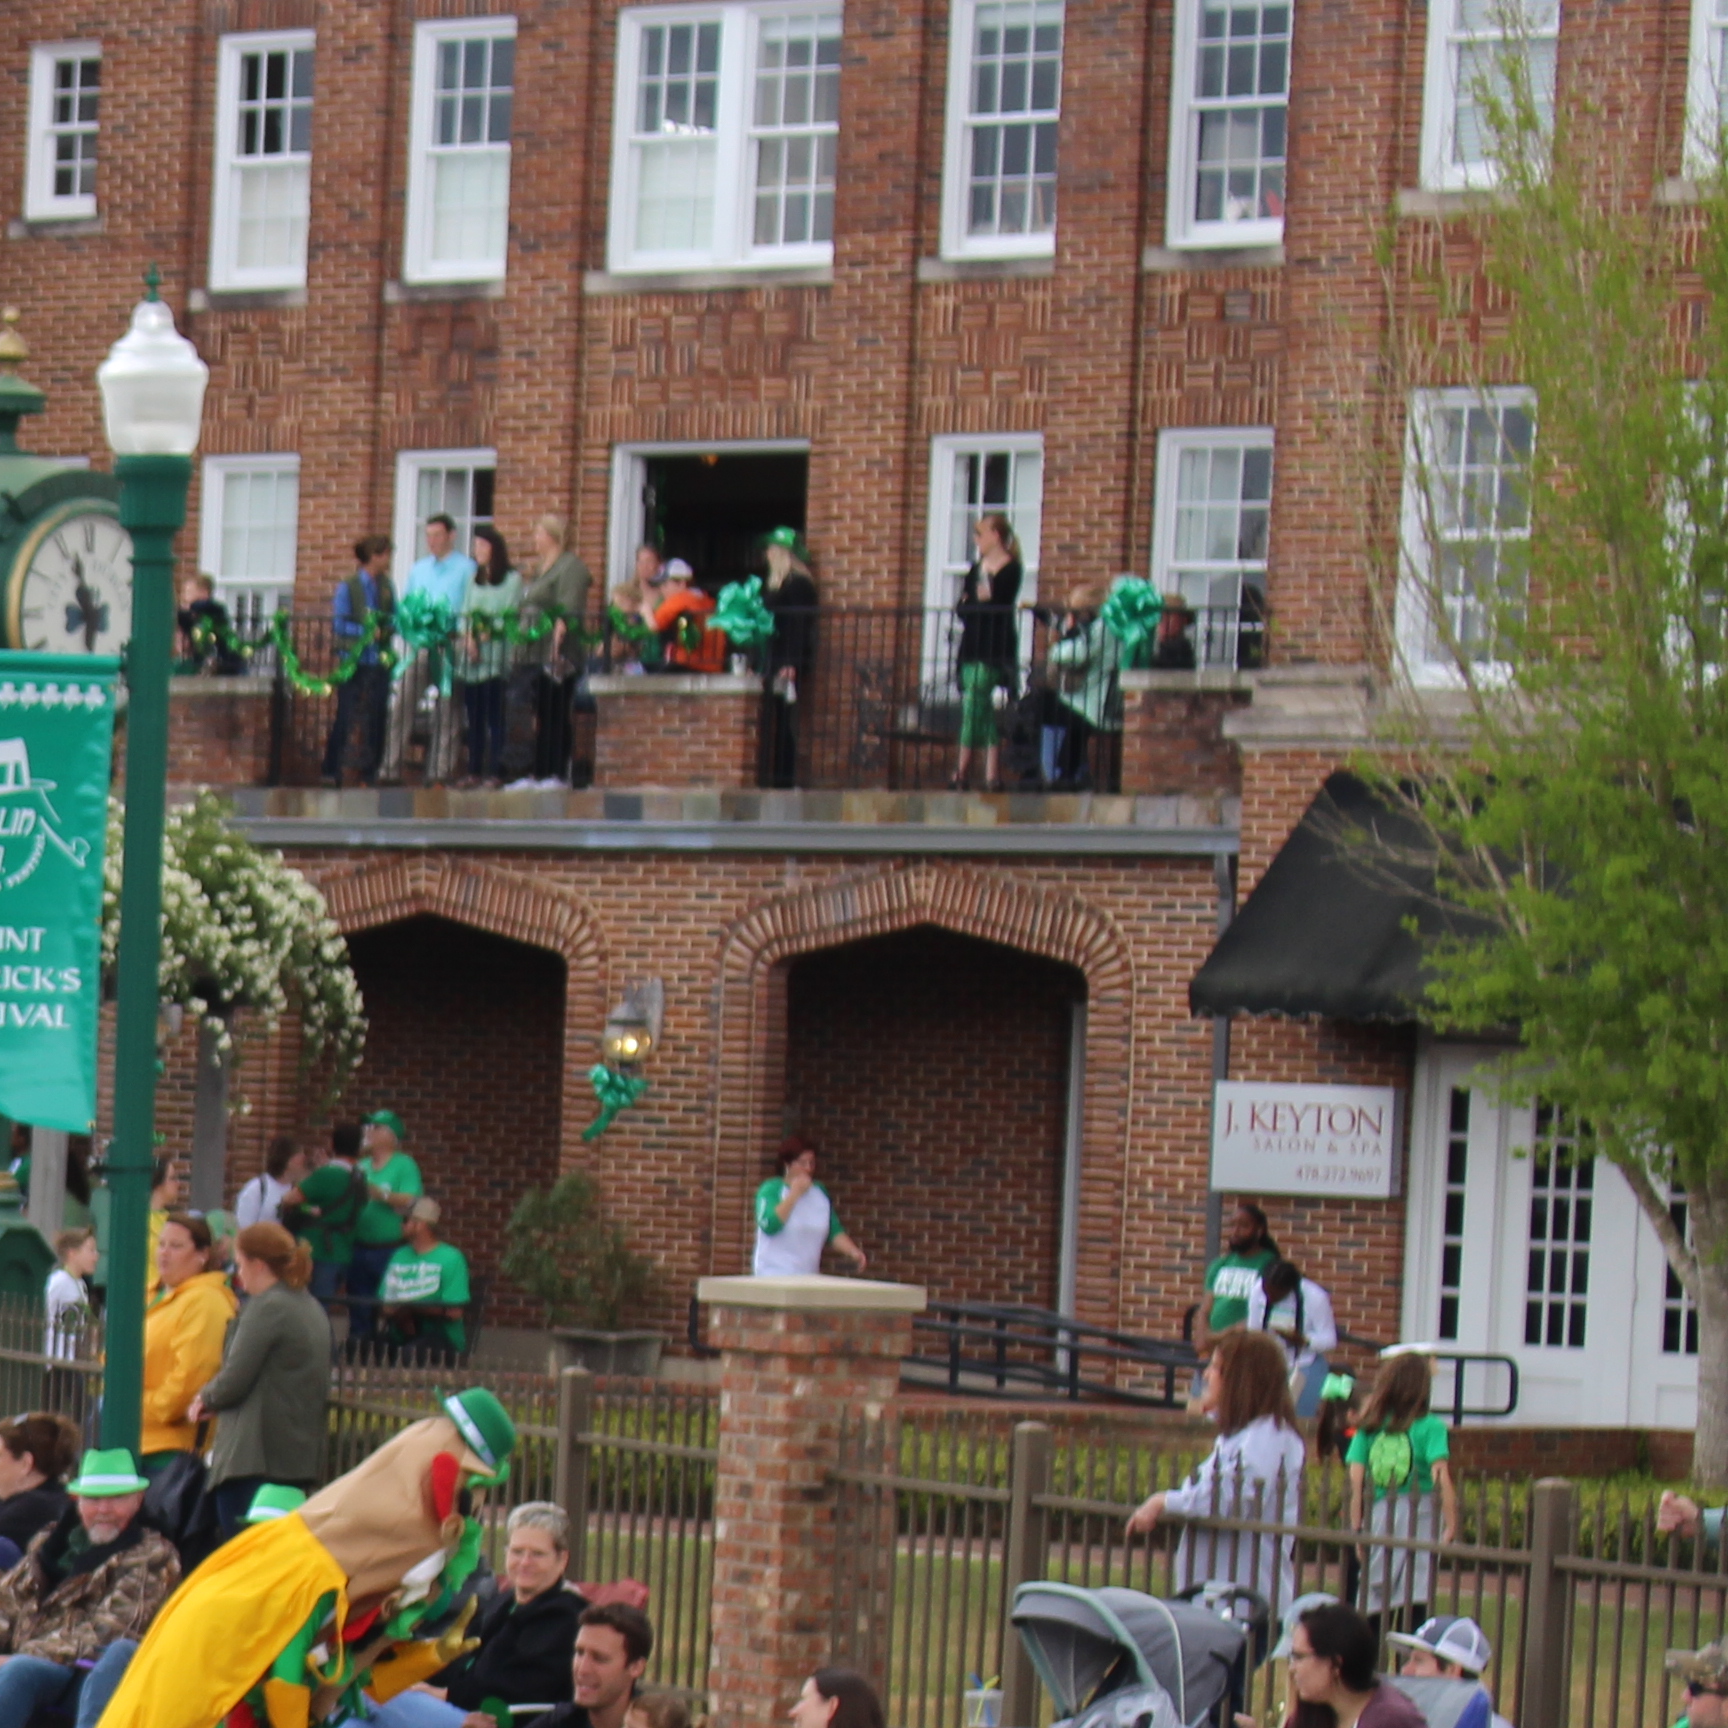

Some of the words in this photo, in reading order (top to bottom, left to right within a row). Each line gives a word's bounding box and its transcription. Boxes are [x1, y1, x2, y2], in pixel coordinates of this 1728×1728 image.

[1224, 1102, 1240, 1139] J.
[1249, 1102, 1383, 1136] KEYTON
[1253, 1137, 1317, 1154] SALON
[1350, 1140, 1383, 1157] SPA
